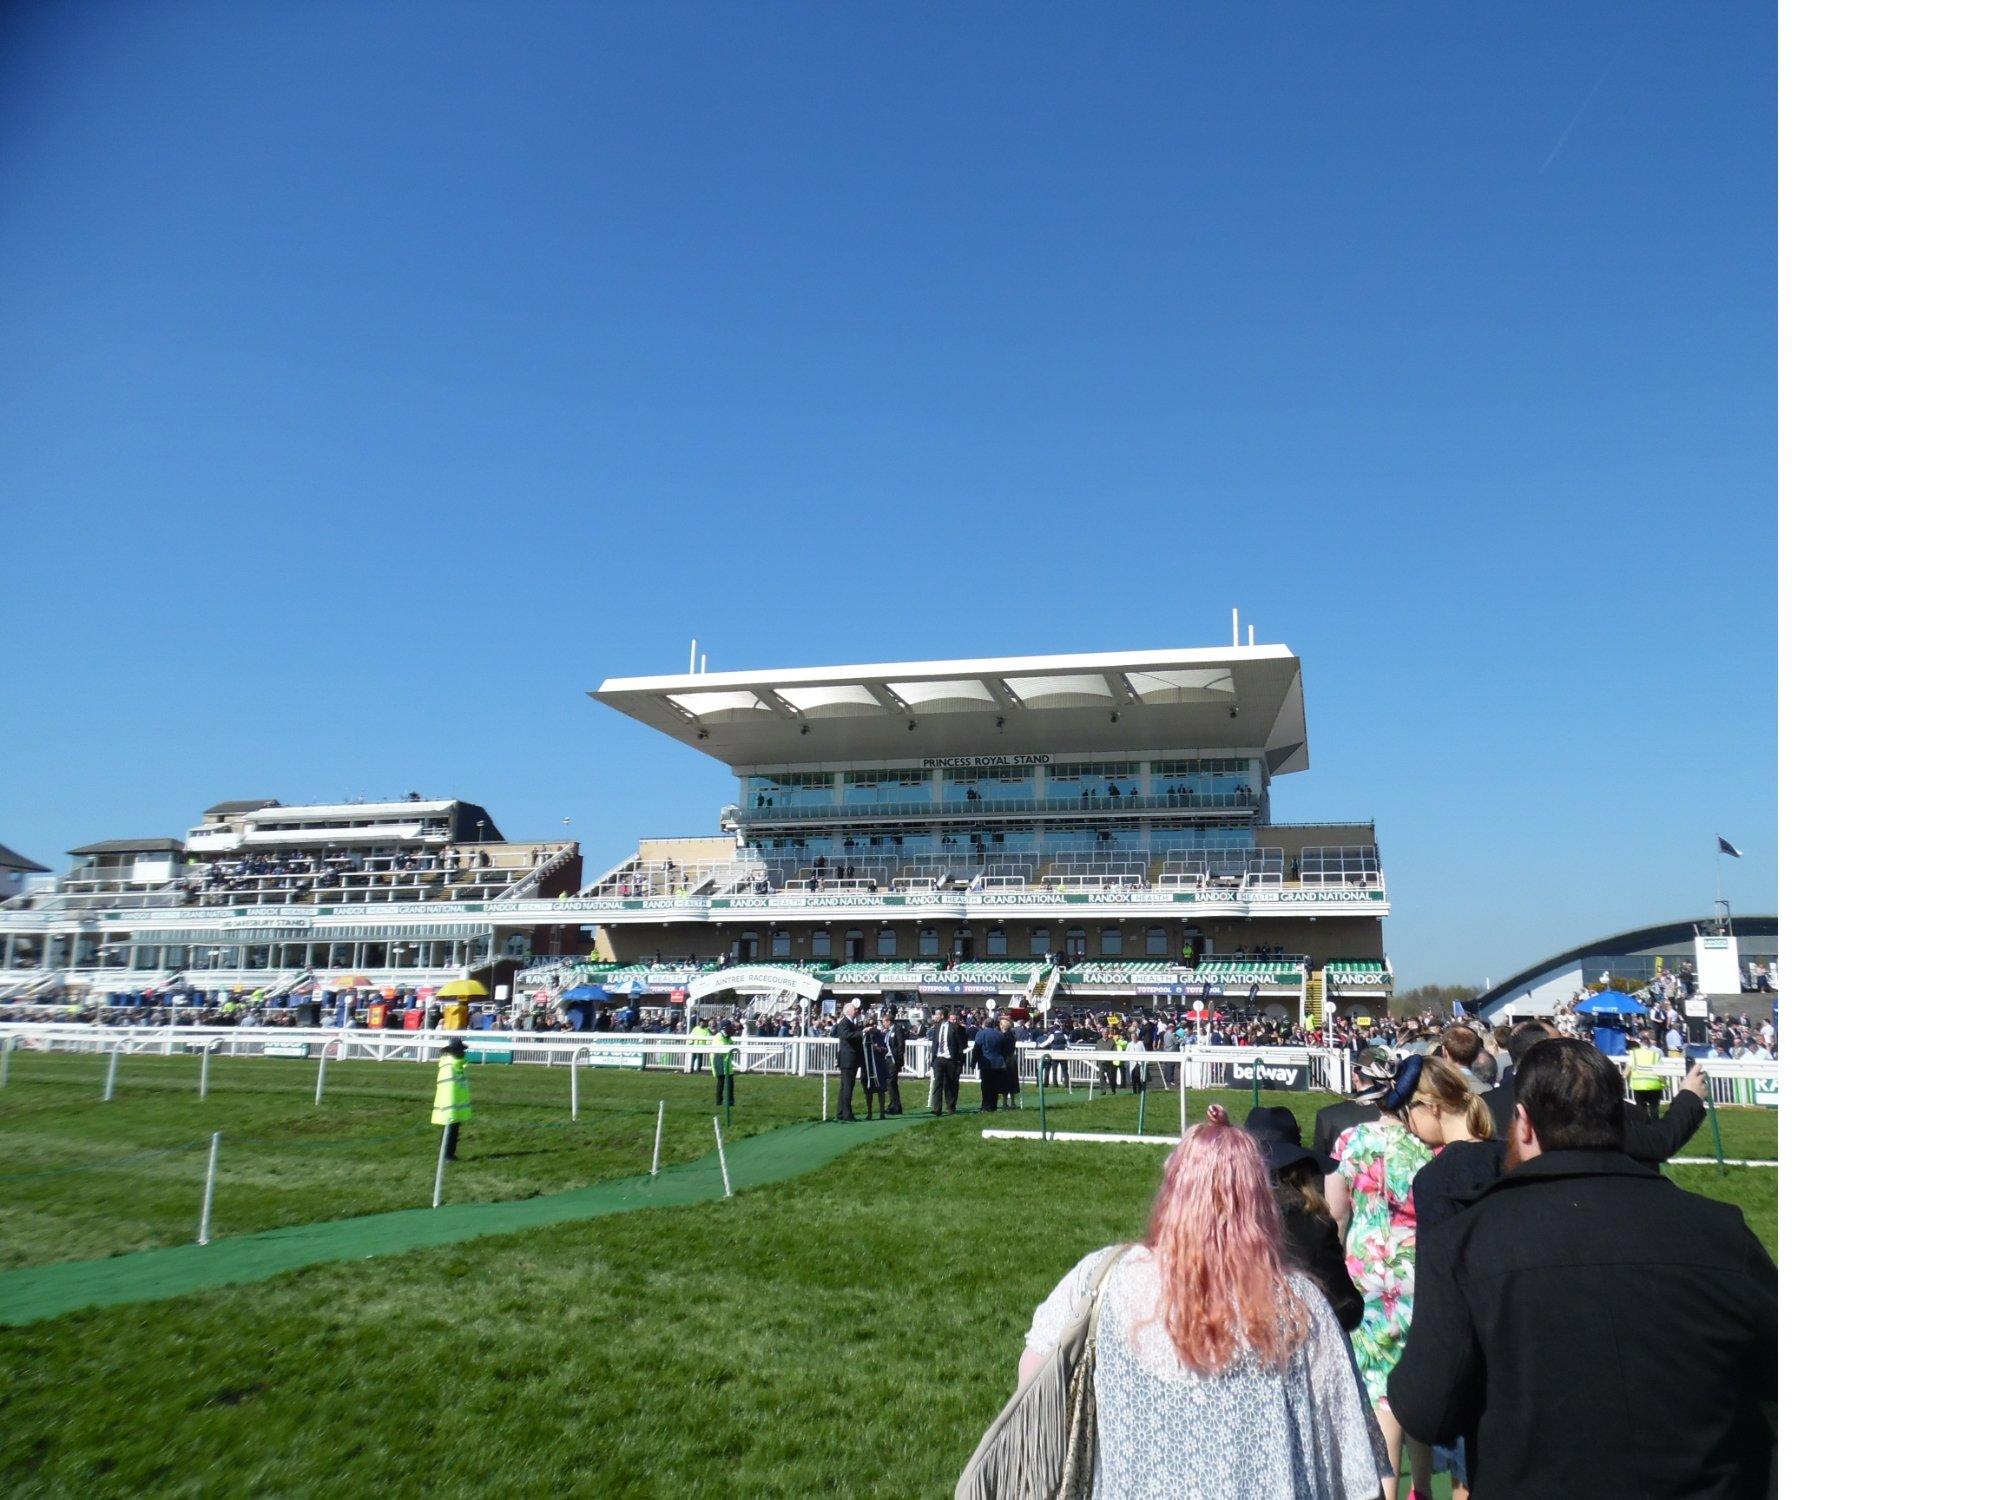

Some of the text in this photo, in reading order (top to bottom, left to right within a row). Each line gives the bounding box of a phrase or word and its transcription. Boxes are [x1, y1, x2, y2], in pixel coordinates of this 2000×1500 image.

[923, 754, 1050, 767] PRINCESS ROYAL STAND
[905, 896, 940, 904] RANDOX
[983, 895, 1016, 904] GRAND
[1018, 894, 1067, 903] NATIONAL
[1088, 894, 1130, 903] RANDOX
[1195, 892, 1235, 901] RANDOX
[1280, 892, 1317, 901] GRAND
[1319, 891, 1372, 901] NATIONAL
[483, 903, 516, 911] RANDOX
[553, 902, 582, 910] GRAND
[583, 901, 624, 910] NATIONAL
[643, 900, 673, 909] RANDOX
[730, 899, 766, 907] RANDOX
[807, 898, 840, 906] GRAND
[840, 896, 885, 906] NATIONAL
[247, 908, 278, 916] RANDOX
[333, 907, 365, 915] RANDOX
[400, 905, 426, 914] GRAND
[426, 904, 466, 914] NATIONAL
[607, 974, 646, 984] RANDOX
[715, 974, 745, 986] AINTREE
[749, 974, 798, 988] RACECOURSE
[834, 973, 1014, 983] RANDOX HEALTH GRAND NATIONAL
[1083, 974, 1129, 984] RANDOX
[1180, 973, 1218, 984] GRAND
[1220, 973, 1278, 984] NATIONAL
[1333, 974, 1382, 984] RANDOX
[1233, 1063, 1298, 1085] betway
